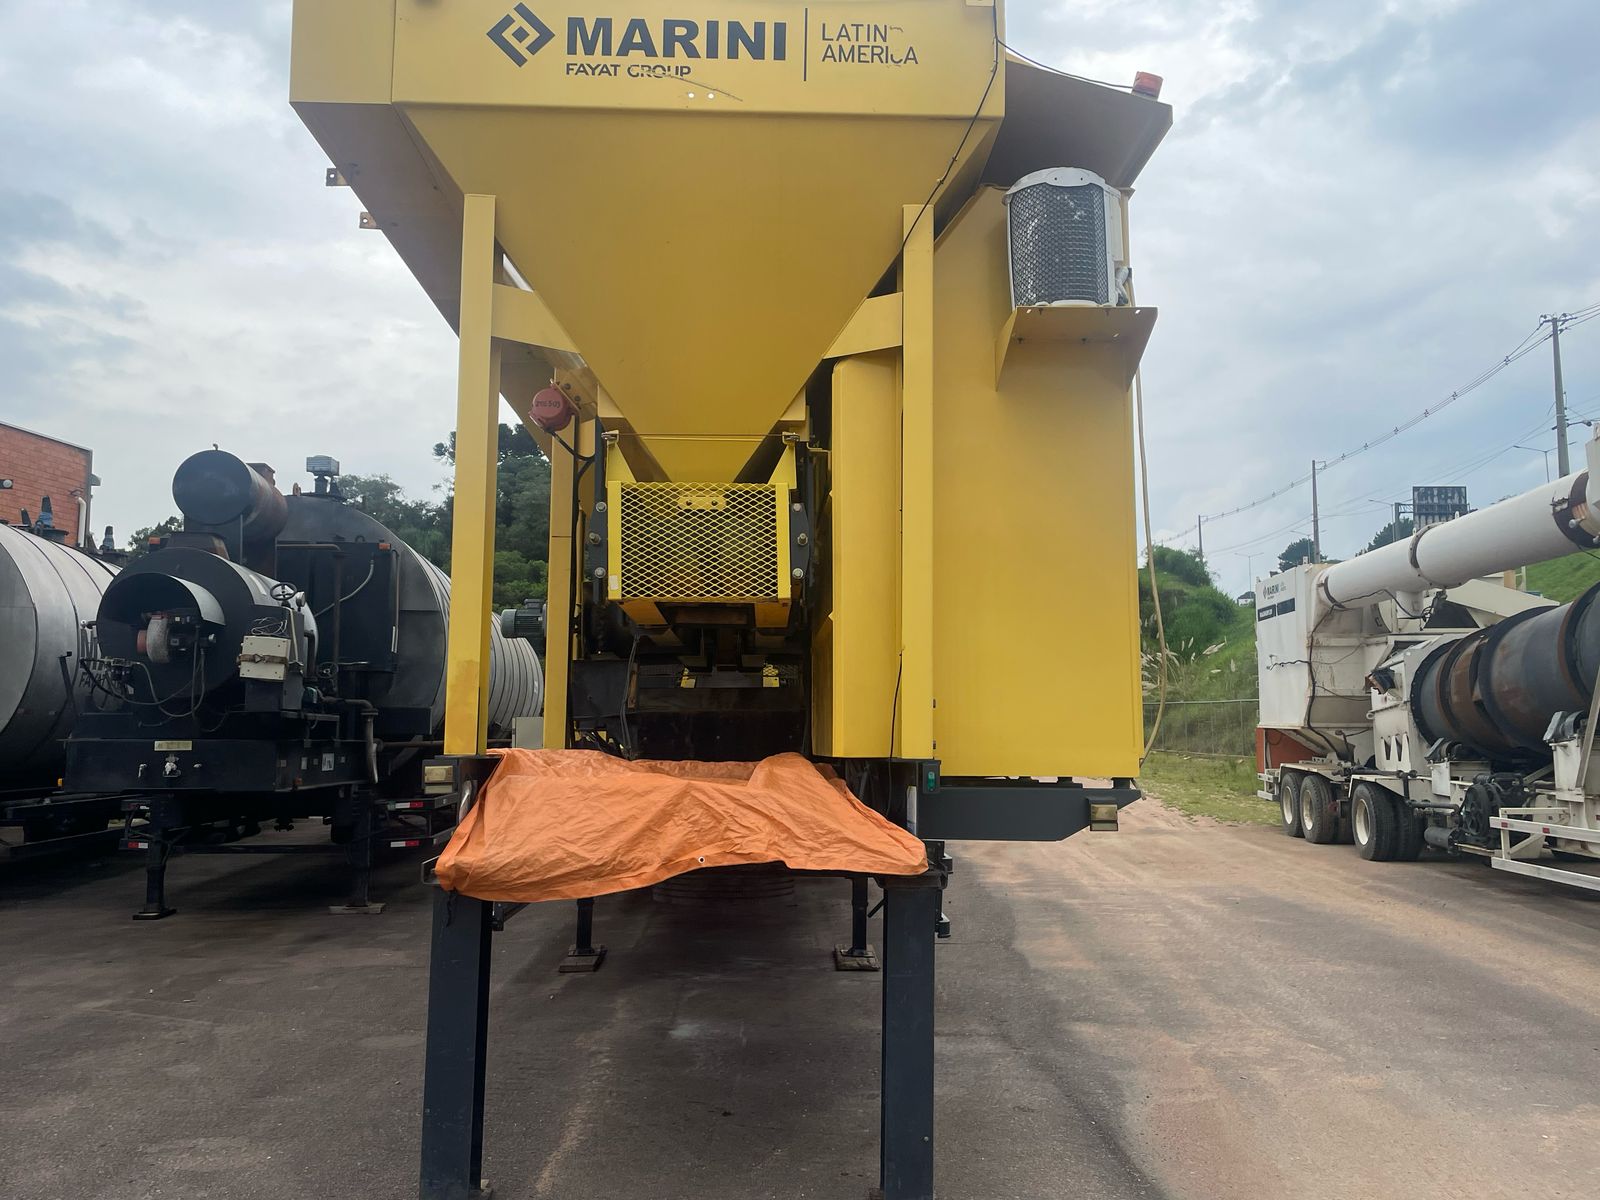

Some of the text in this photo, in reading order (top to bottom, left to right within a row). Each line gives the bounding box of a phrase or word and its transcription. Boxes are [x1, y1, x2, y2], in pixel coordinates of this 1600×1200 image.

[566, 17, 787, 61] MARINI
[821, 23, 888, 43] LATIN
[565, 62, 621, 77] FAYAT
